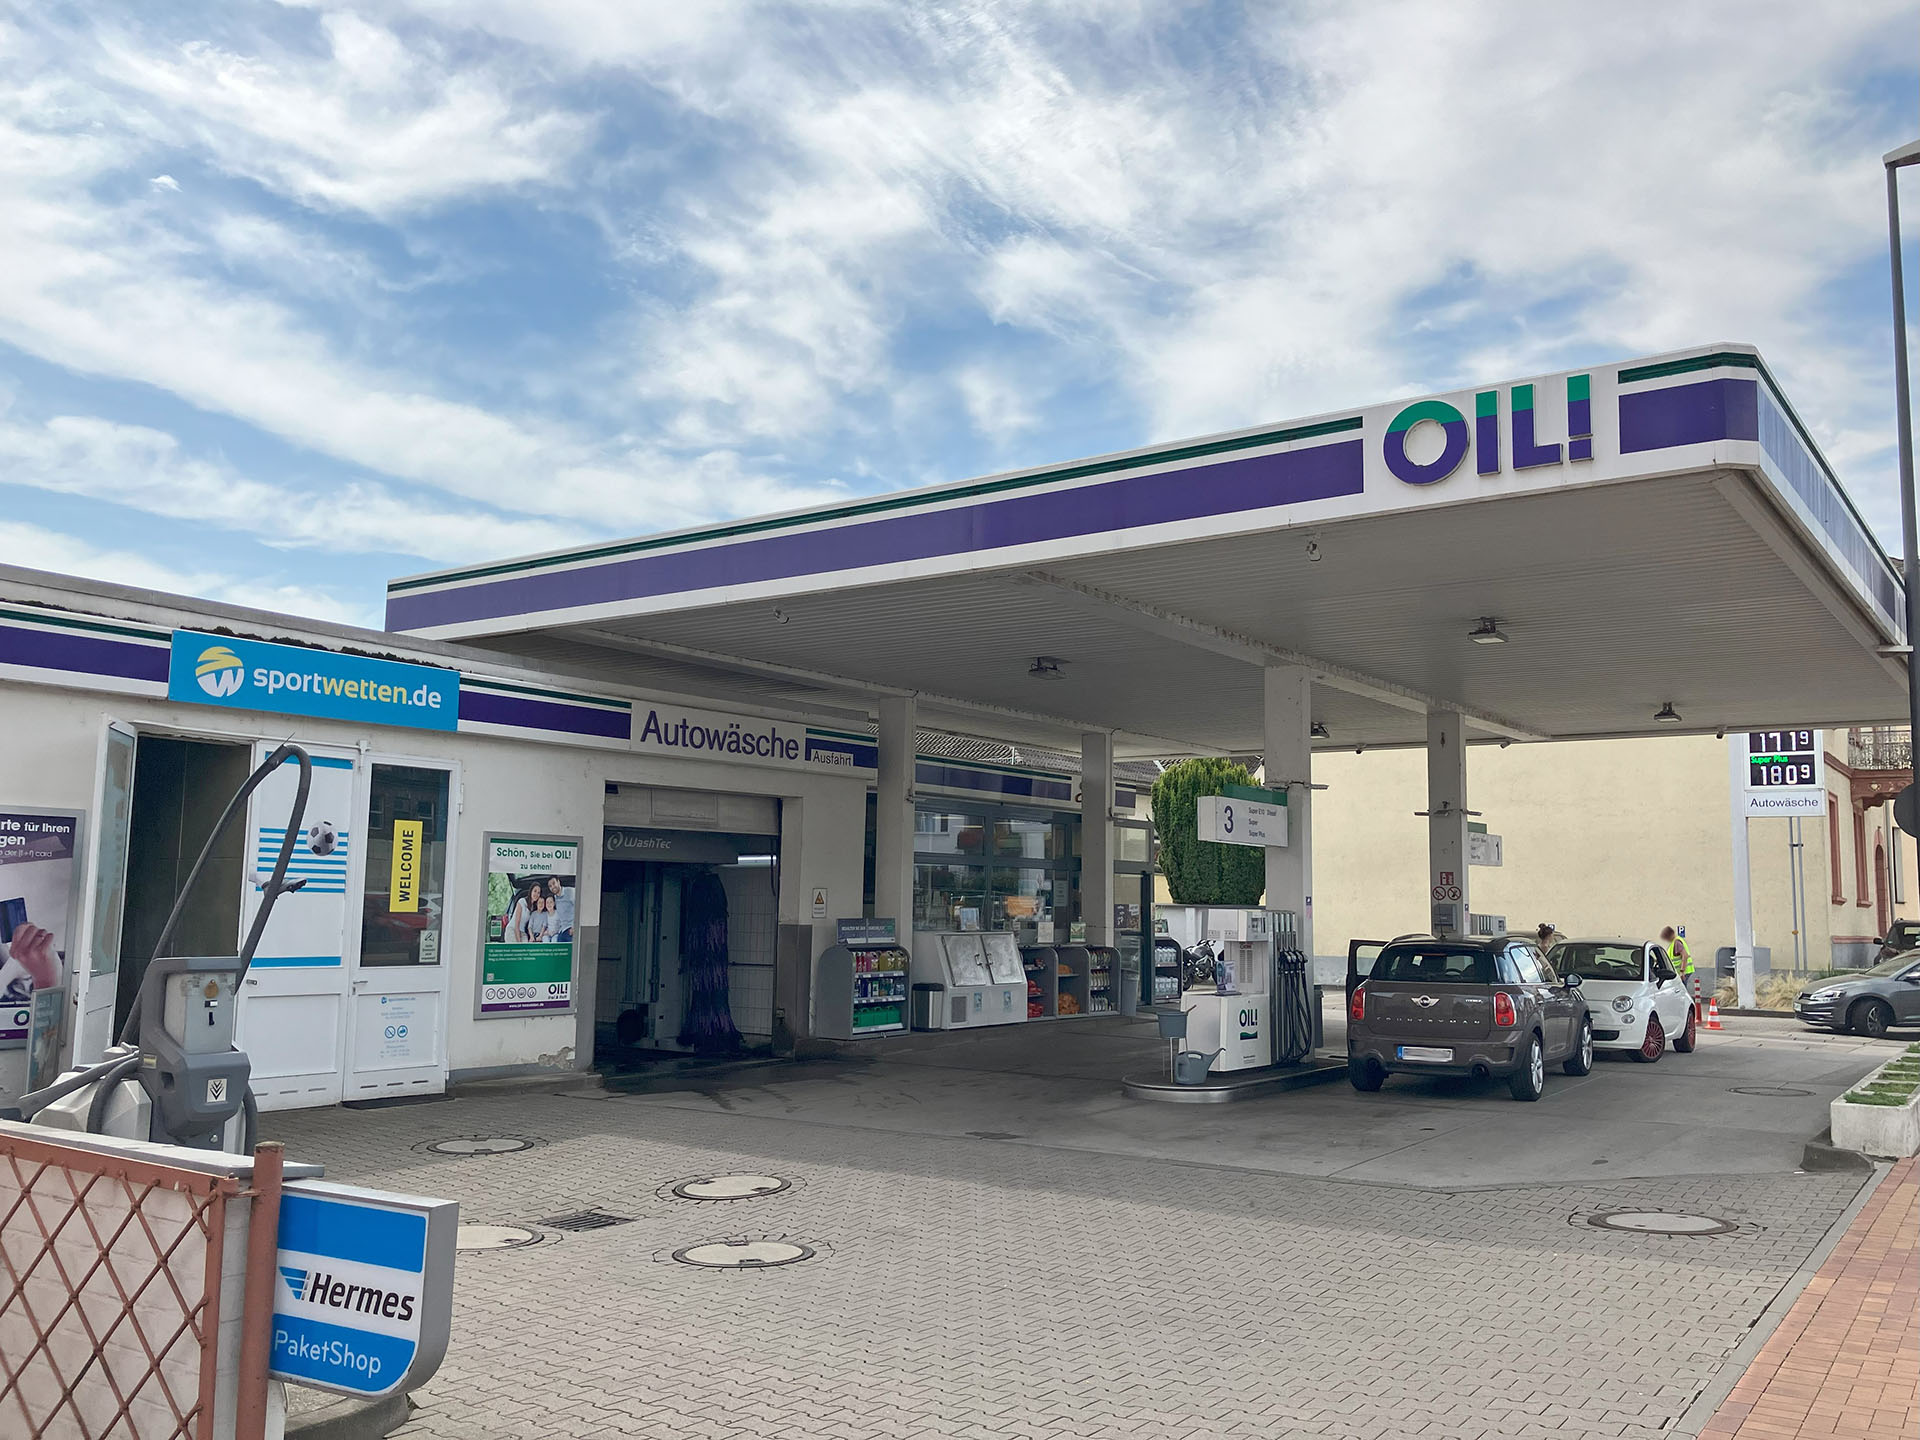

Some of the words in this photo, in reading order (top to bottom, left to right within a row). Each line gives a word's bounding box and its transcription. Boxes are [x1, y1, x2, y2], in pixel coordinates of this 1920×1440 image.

[1383, 373, 1593, 486] OIL!
[253, 668, 442, 709] sportwetten.de
[640, 710, 799, 760] Autowäsche
[813, 751, 852, 766] Ausfahrt
[1751, 756, 1772, 765] Super
[1773, 755, 1788, 763] Plus
[1750, 797, 1819, 808] Autowäsche
[24, 822, 40, 832] für
[42, 823, 70, 833] Ihren
[1224, 805, 1234, 833] 3
[624, 837, 672, 850] WashTec
[496, 847, 528, 859] Schön,
[530, 850, 540, 858] Sie
[542, 851, 553, 859] bei
[554, 849, 572, 860] OIL!
[398, 829, 414, 903] WELCOME
[530, 863, 552, 871] sehen!
[548, 983, 568, 995] OIL!
[1239, 1008, 1258, 1028] OIL!
[308, 1272, 415, 1321] Hermes
[274, 1329, 381, 1379] PaketShop
